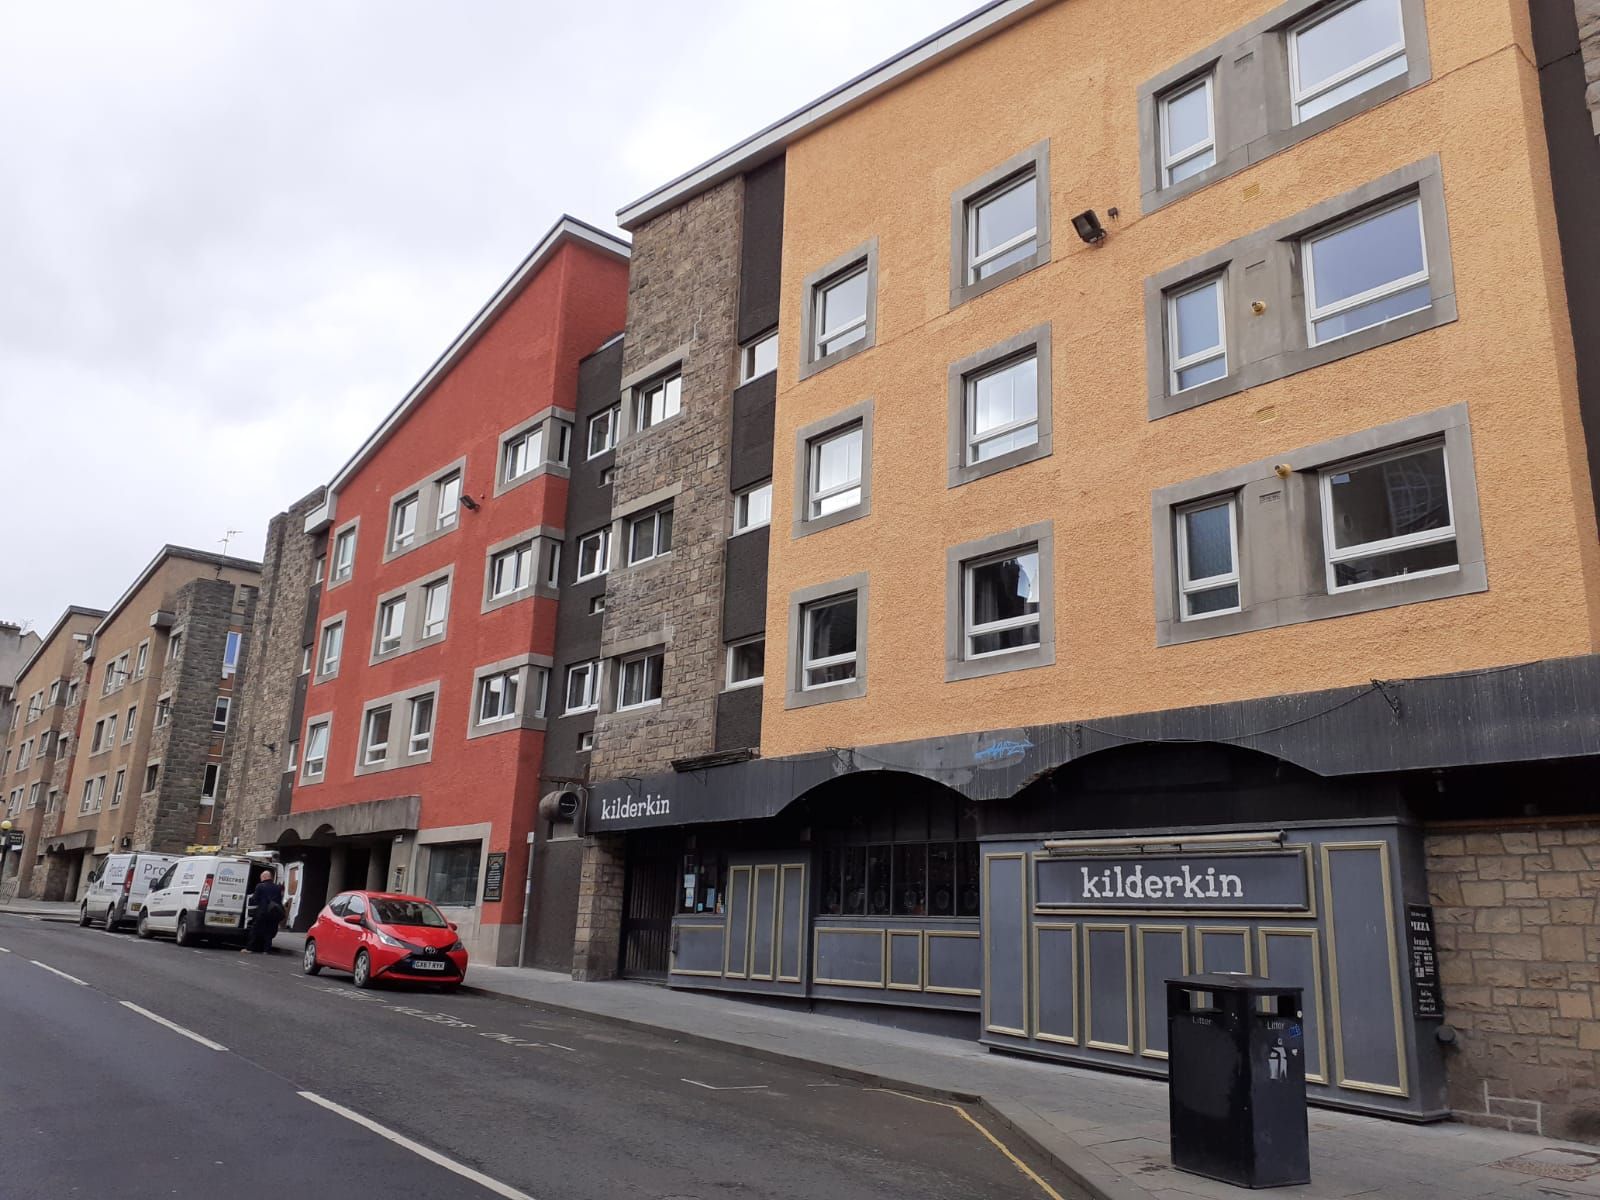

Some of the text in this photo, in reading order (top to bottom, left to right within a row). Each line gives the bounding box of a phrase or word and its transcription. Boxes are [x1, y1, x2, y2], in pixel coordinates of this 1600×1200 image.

[601, 794, 670, 819] kilderkin
[1081, 865, 1243, 898] kilderkin
[1192, 1016, 1212, 1025] Litter
[1267, 1021, 1285, 1030] Litter
